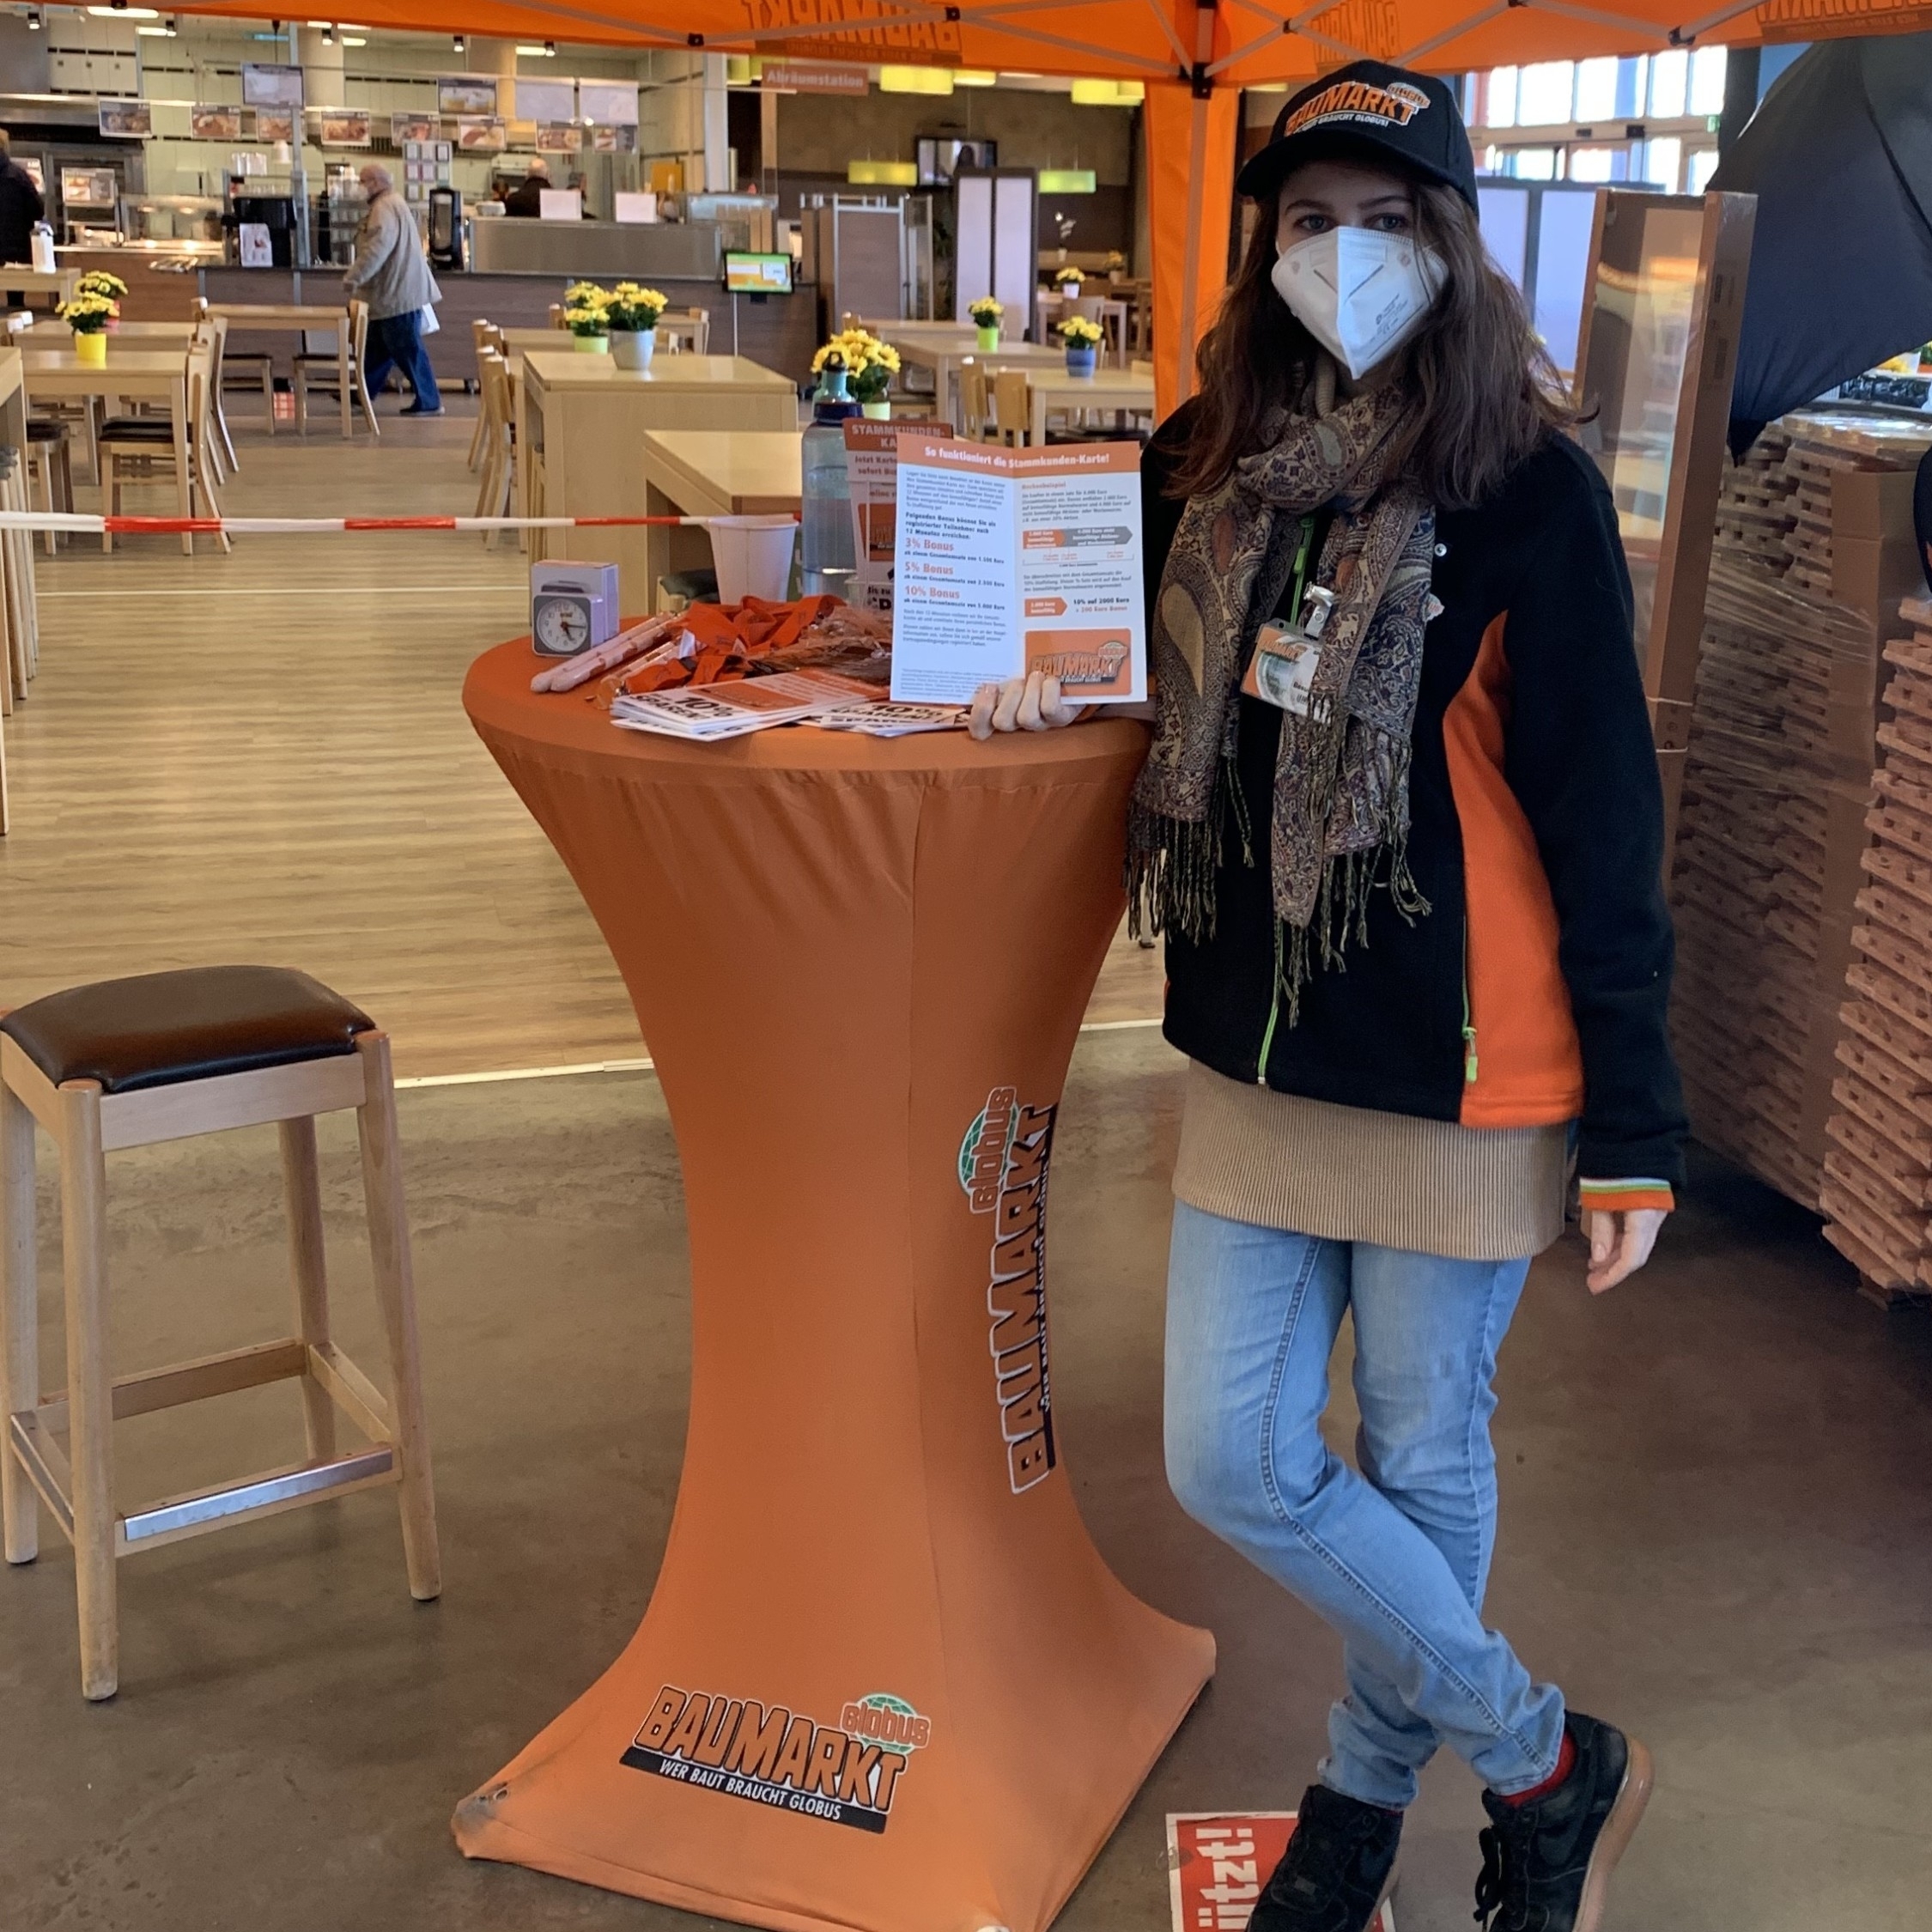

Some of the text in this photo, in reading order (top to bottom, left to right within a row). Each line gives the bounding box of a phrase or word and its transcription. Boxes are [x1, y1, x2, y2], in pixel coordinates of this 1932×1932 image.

[767, 70, 864, 88] Abräumstation
[1285, 81, 1417, 137] BAUMARKT
[880, 438, 897, 447] KA
[925, 447, 1109, 469] So funktioniert die Stammkunden-Karte!
[905, 538, 921, 549] 3%
[924, 539, 955, 551] Bonus
[905, 562, 954, 574] 5% Bonus
[905, 585, 960, 599] 10% Bonus
[674, 696, 732, 716] 10%
[987, 1104, 1057, 1494] BAUMARKT
[634, 1684, 908, 1814] BAUMARKT
[659, 1758, 842, 1821] WER BAUT BRAUCHT GLOBUS
